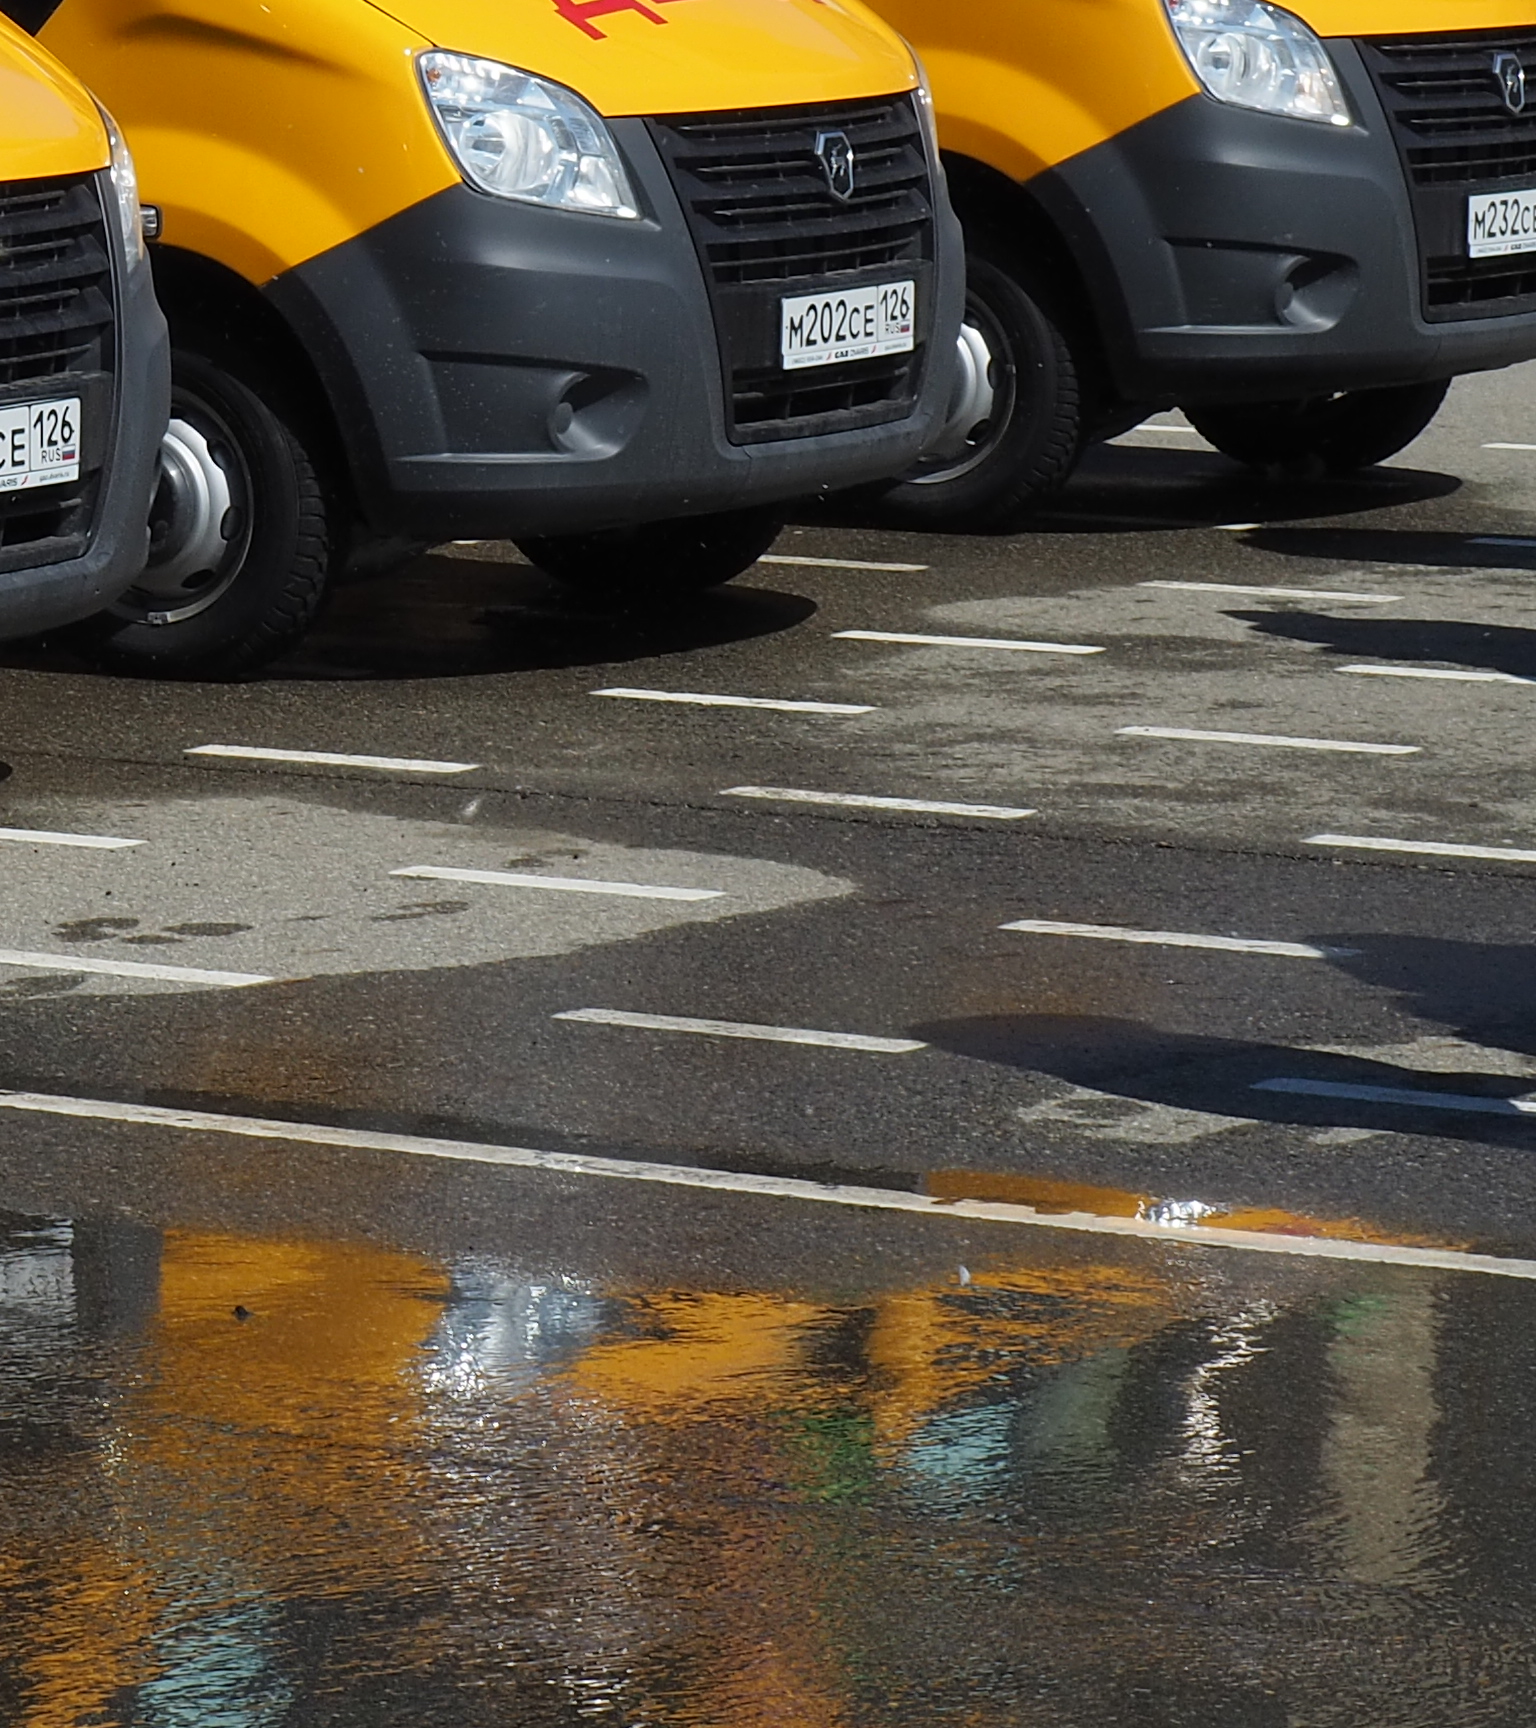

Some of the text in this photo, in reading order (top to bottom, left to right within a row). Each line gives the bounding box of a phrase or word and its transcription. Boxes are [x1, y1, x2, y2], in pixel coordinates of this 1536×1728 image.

[880, 287, 910, 322] 126
[33, 406, 75, 449] 126
[41, 448, 61, 464] RUS
